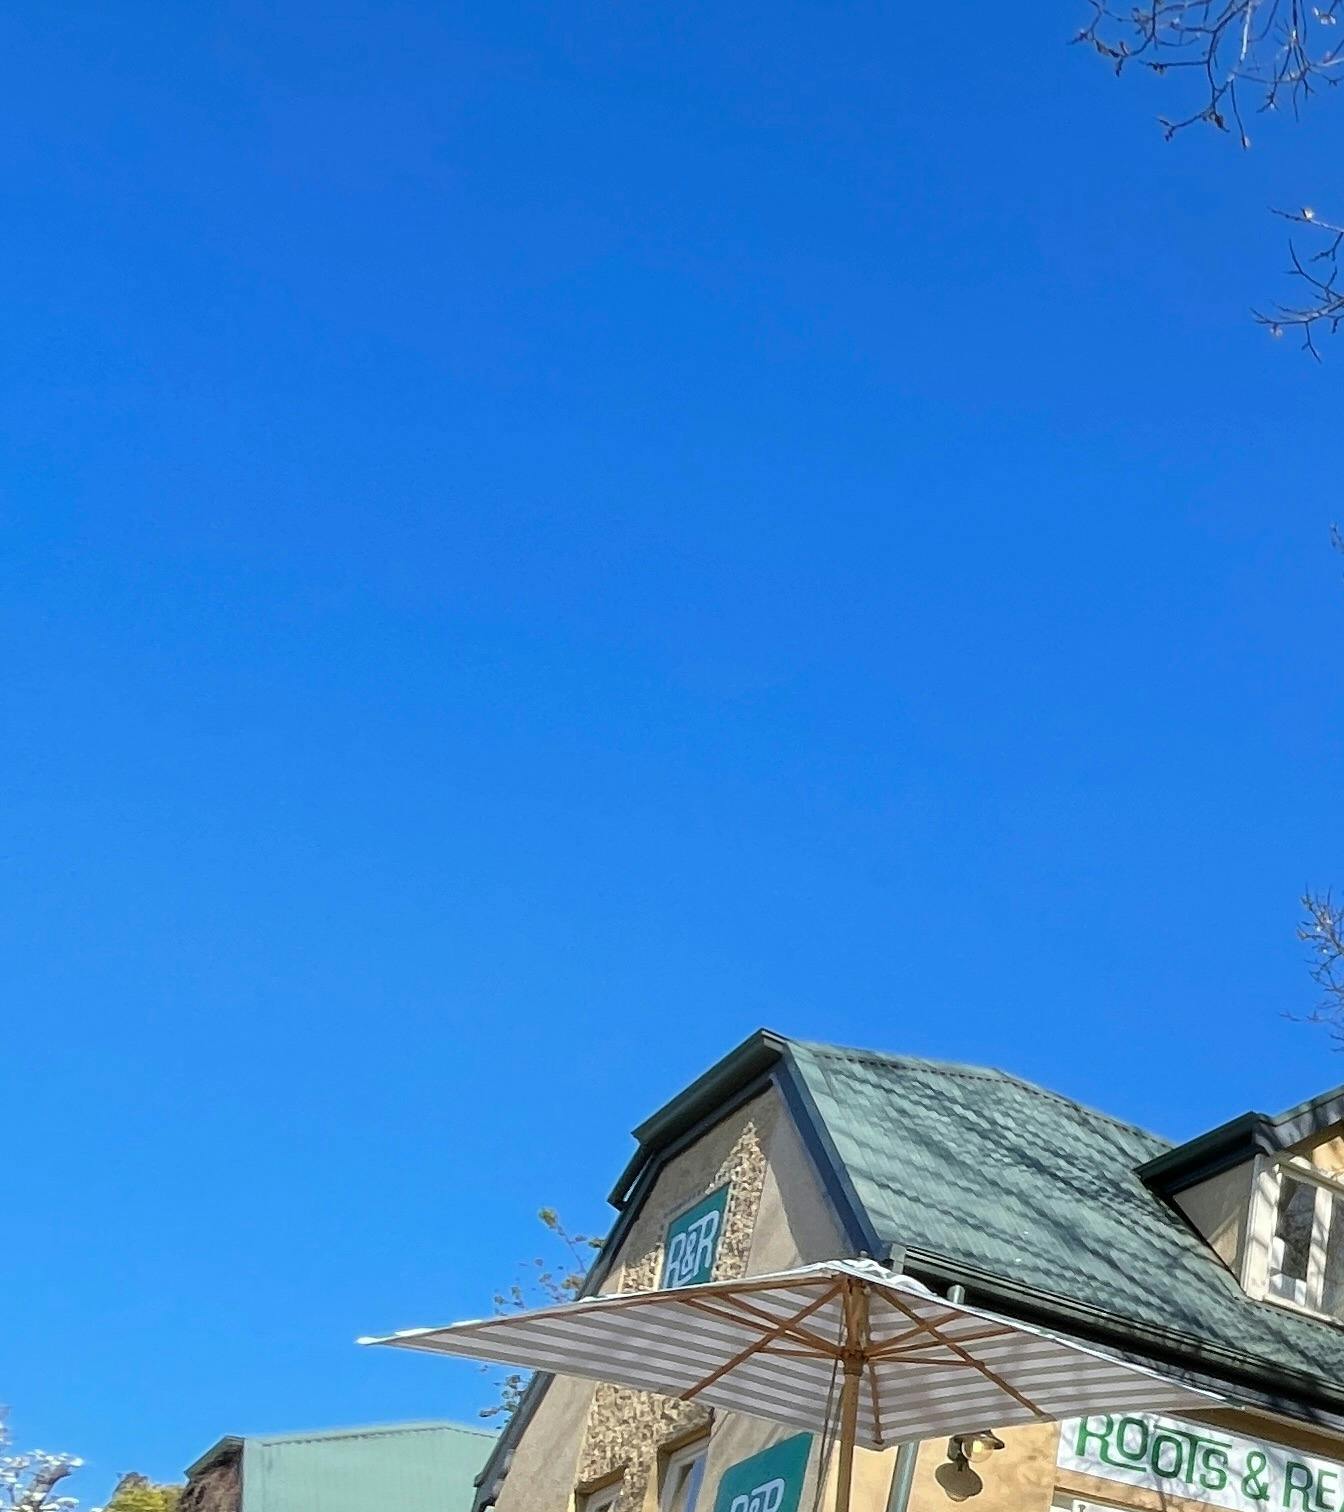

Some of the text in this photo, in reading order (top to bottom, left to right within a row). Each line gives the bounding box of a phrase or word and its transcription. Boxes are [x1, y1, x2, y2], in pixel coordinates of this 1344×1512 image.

[663, 1210, 719, 1288] R&R
[1074, 1414, 1233, 1491] ROOTS
[1241, 1450, 1270, 1502] &
